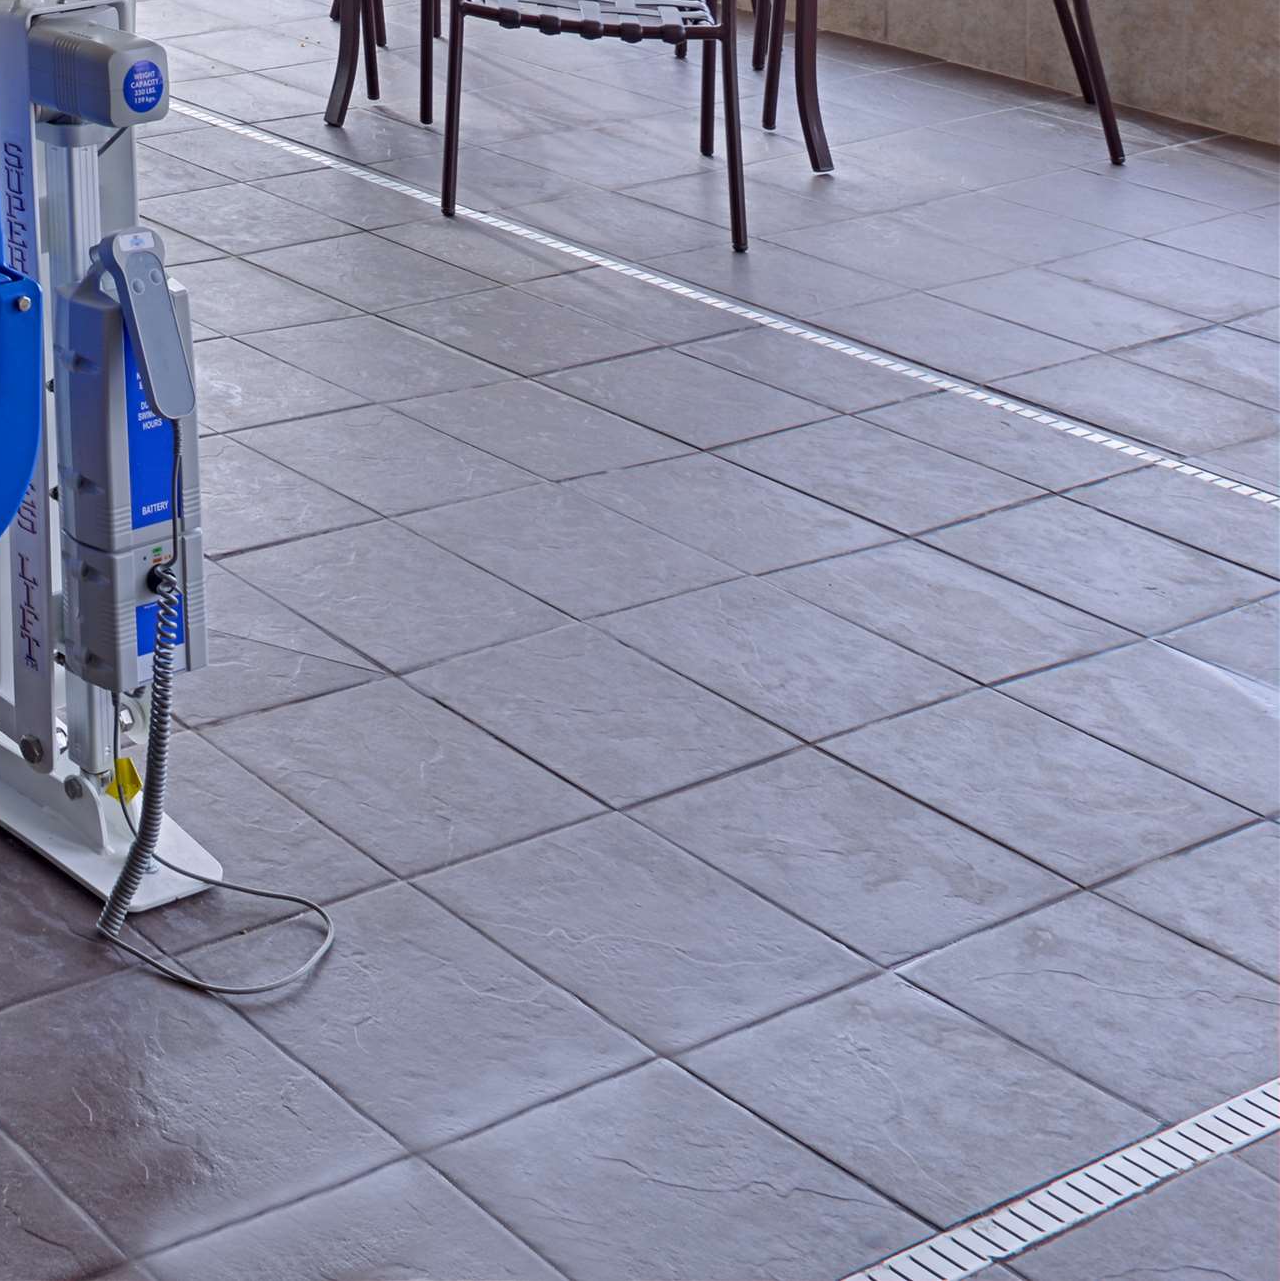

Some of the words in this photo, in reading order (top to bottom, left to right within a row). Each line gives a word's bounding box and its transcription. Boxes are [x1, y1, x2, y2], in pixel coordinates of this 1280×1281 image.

[134, 71, 155, 80] WEIGHT
[130, 79, 159, 88] CAPACITY
[142, 418, 163, 431] HOURS
[142, 500, 169, 516] BATTERY
[18, 553, 41, 665] LIFT
